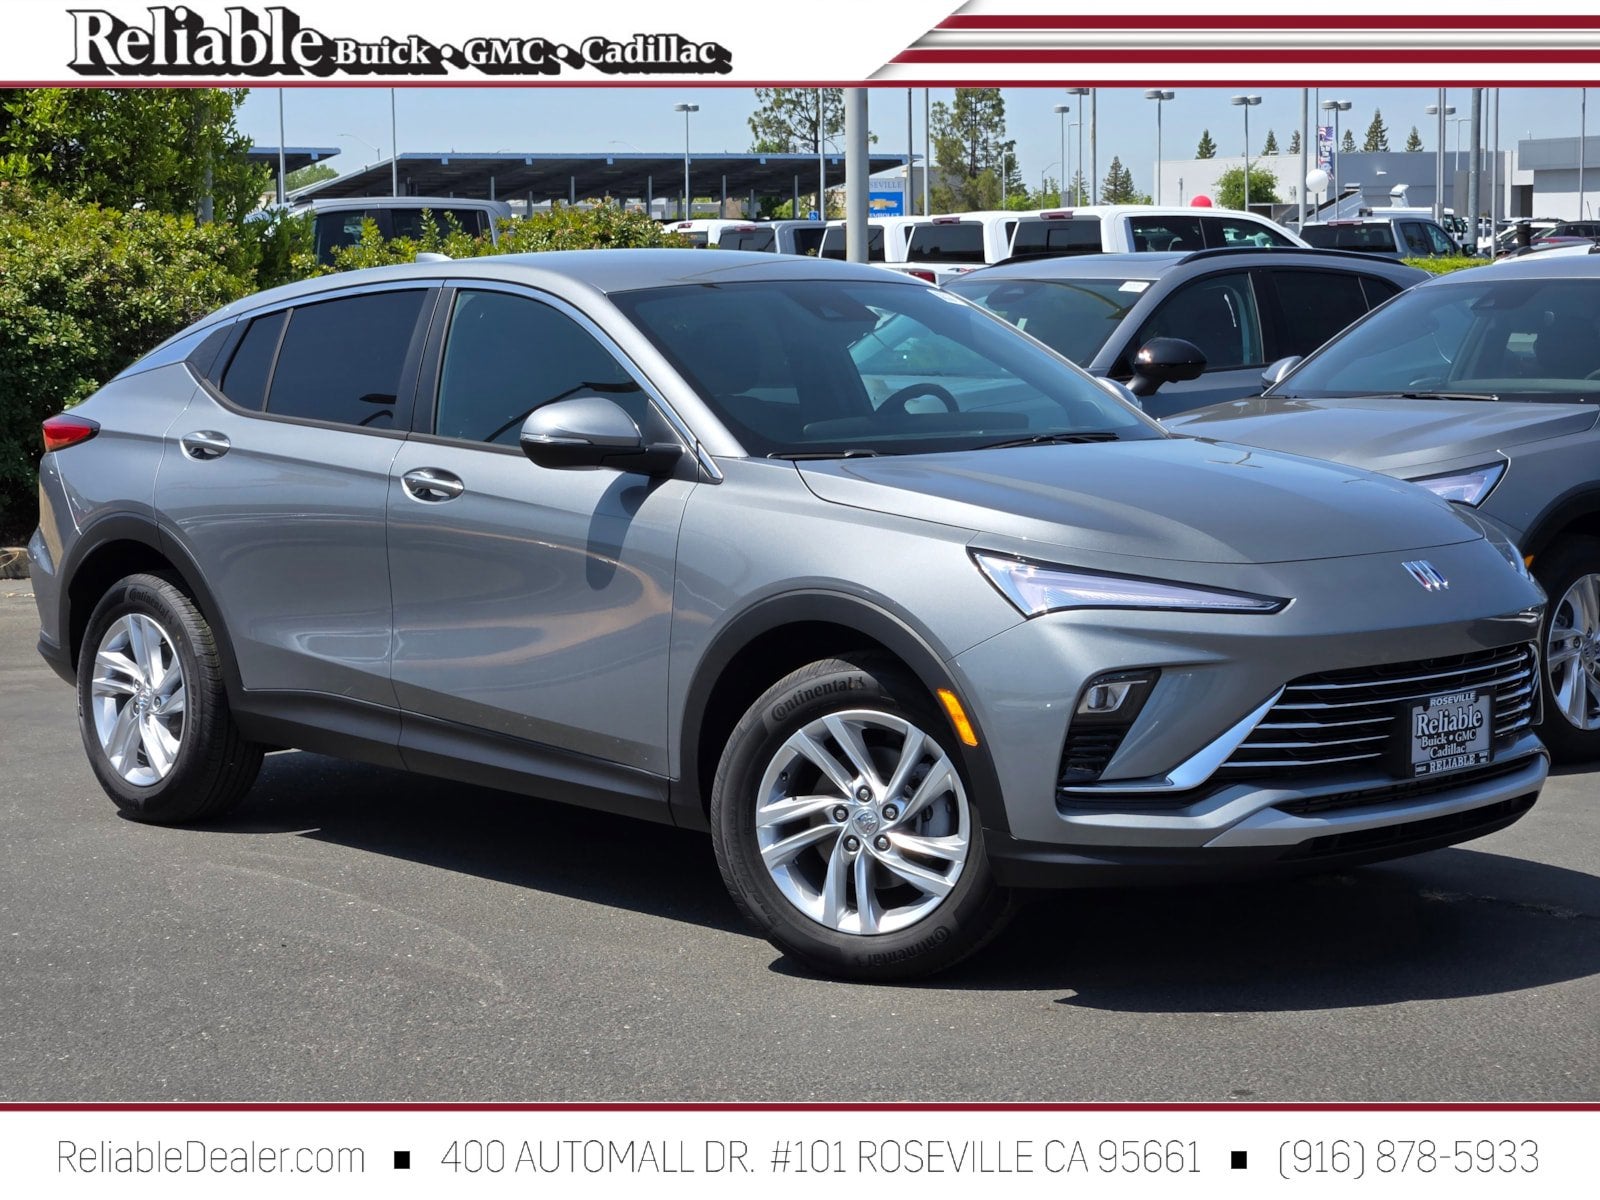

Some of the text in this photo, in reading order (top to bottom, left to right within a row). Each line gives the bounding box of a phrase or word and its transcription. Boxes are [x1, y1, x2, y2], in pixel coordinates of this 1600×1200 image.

[771, 677, 853, 721] Continental
[1430, 691, 1476, 707] ROSEVILLE
[1416, 704, 1482, 738] Reliable
[1421, 729, 1477, 748] Buick GMC
[1430, 744, 1467, 759] Cadillac
[1430, 754, 1476, 773] RELIABLE
